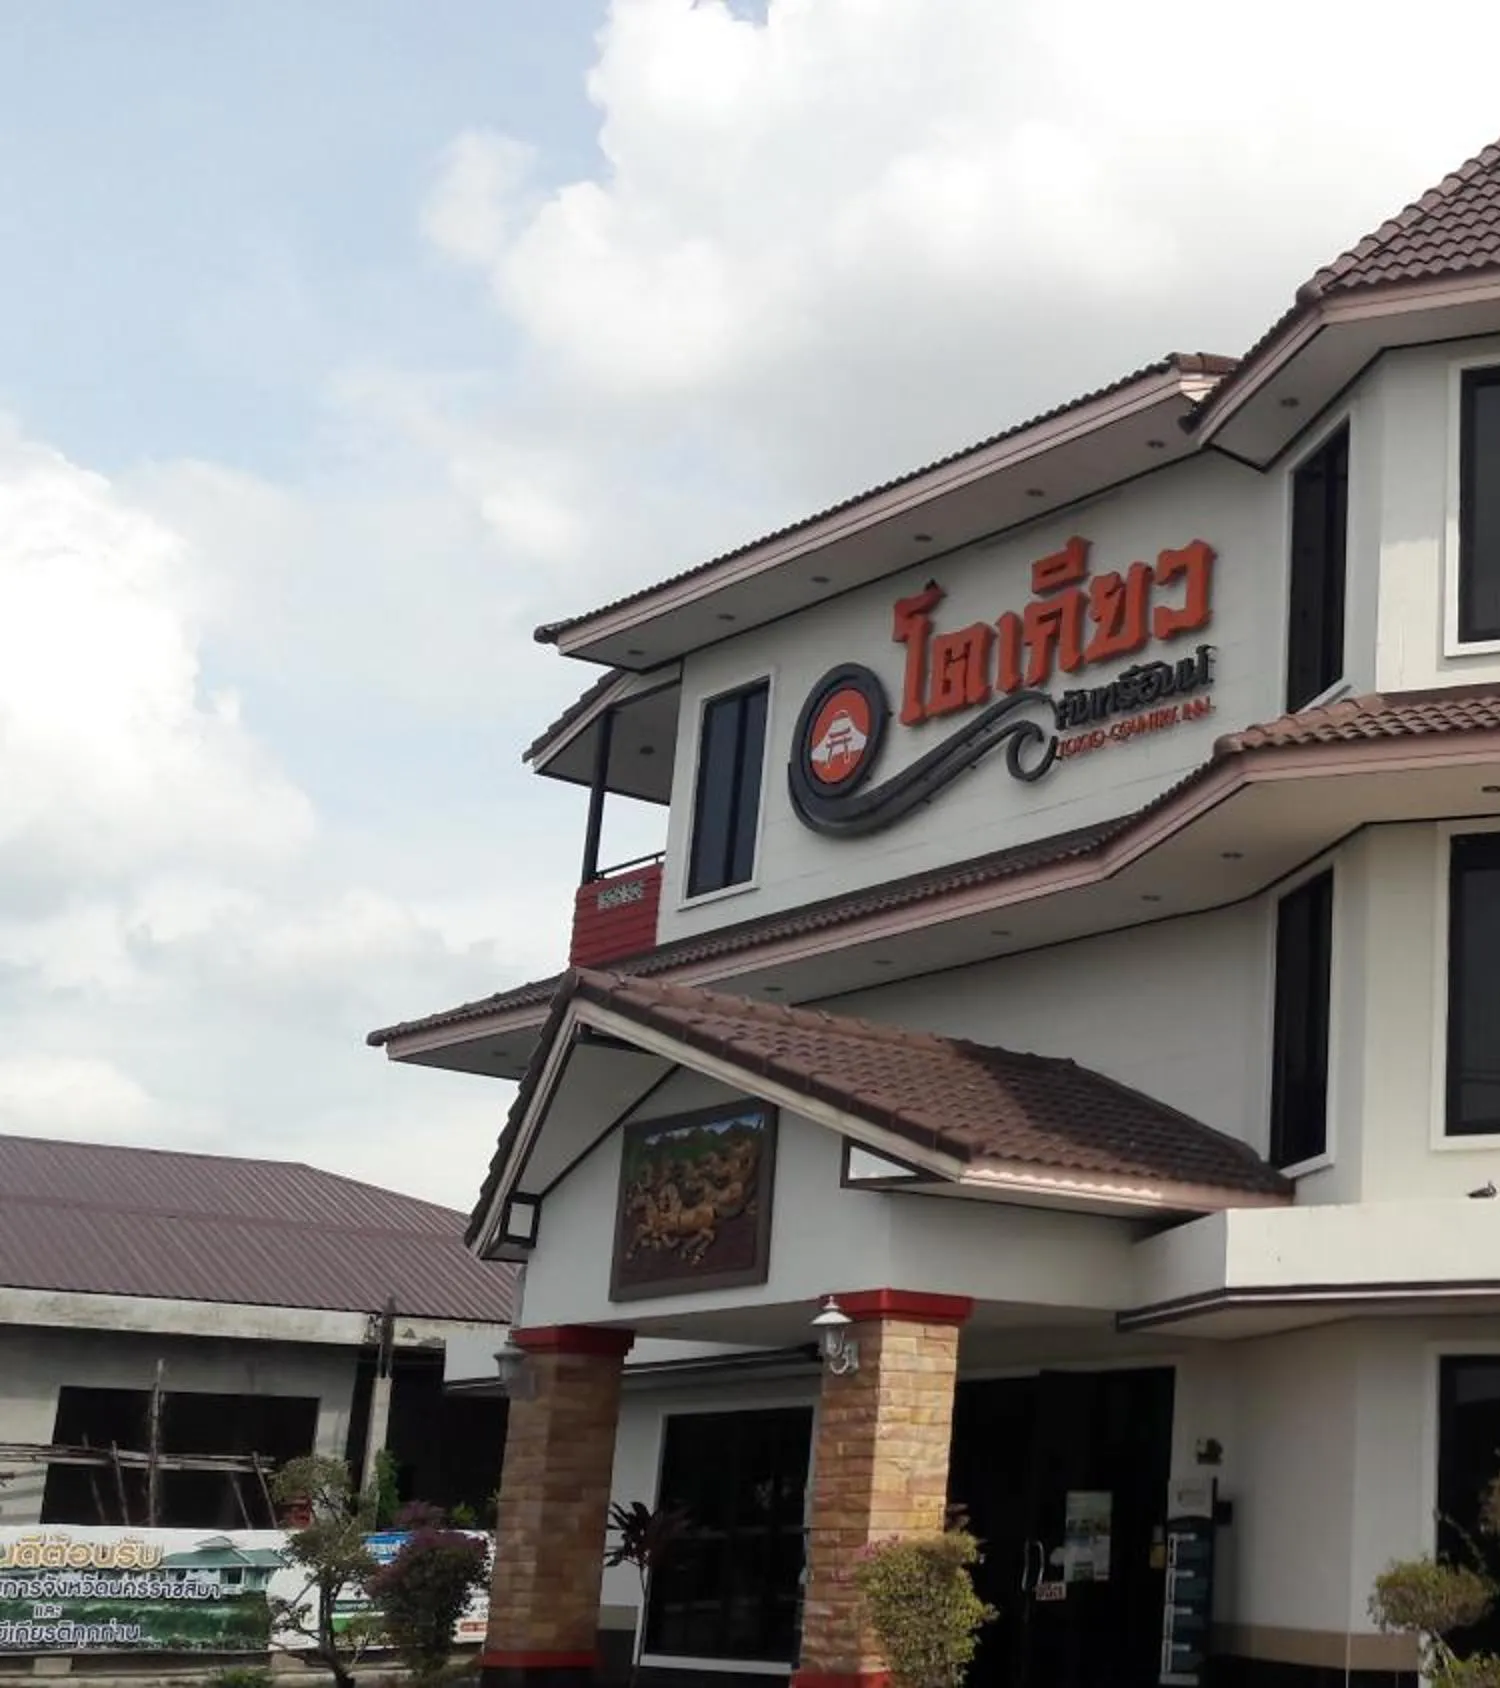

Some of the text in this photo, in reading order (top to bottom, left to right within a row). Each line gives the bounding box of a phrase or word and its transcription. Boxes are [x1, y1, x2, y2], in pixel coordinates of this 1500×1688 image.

[892, 535, 1214, 726] โตเกียว
[0, 1572, 221, 1599] การจังหวัดนครราชสีมา
